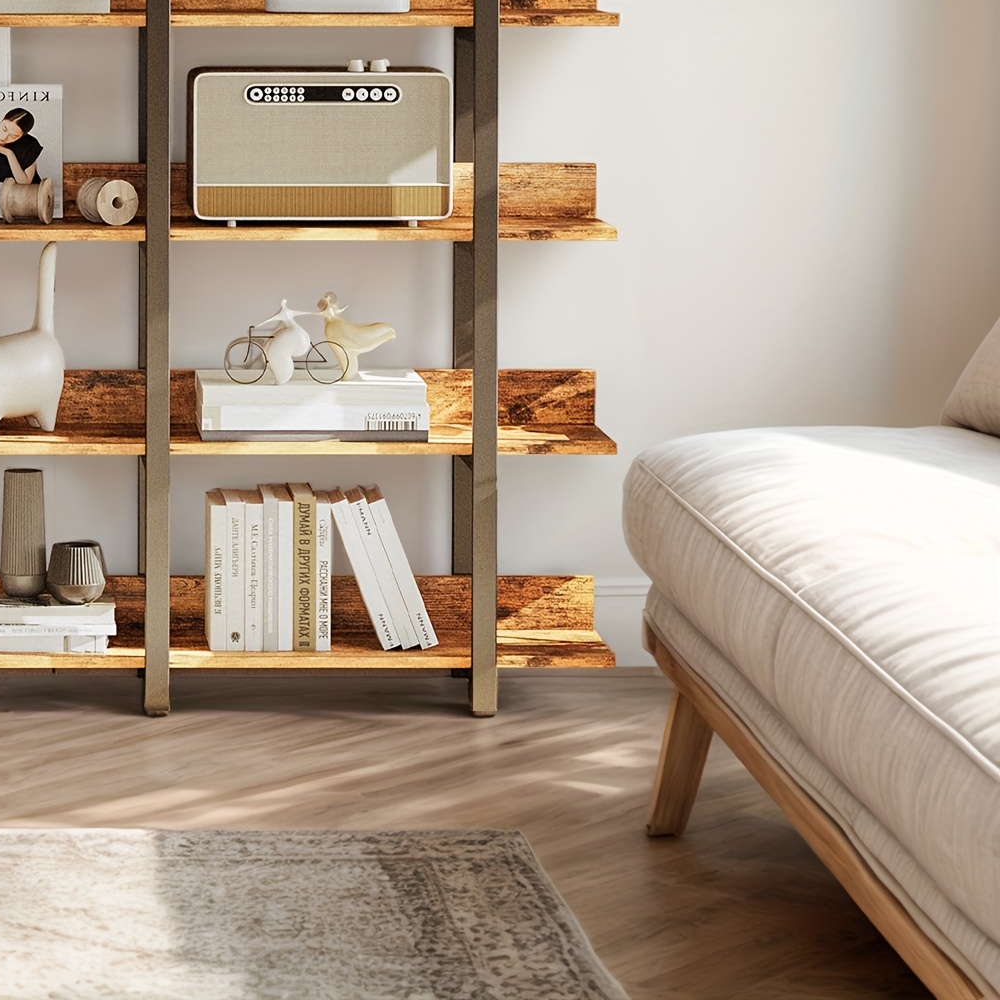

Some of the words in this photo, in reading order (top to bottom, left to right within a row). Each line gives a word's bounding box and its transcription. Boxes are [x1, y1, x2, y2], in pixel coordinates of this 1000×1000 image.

[231, 517, 239, 540] ДАНТЕ
[298, 502, 312, 536] ДУМАЙ
[214, 546, 222, 569] МИРУ
[298, 548, 310, 585] ДРУГИХ
[319, 560, 328, 597] РАССКАЖИ
[298, 587, 310, 638] ФОРМАТАХ
[319, 598, 328, 613] МНЕ
[319, 620, 328, 639] МОРЕ
